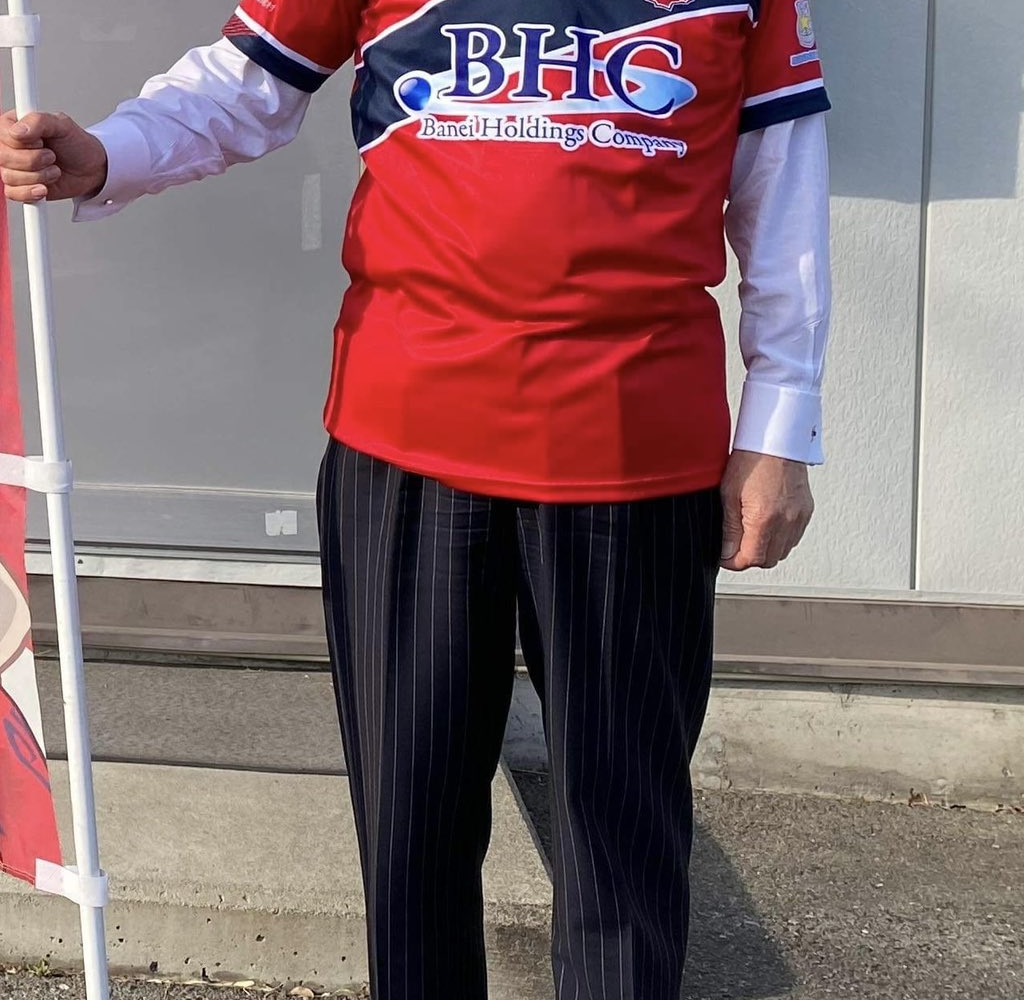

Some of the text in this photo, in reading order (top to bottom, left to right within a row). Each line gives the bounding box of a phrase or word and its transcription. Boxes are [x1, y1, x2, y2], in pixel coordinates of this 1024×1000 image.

[437, 26, 682, 115] BHC
[421, 117, 687, 156] Banei Holdings Company
